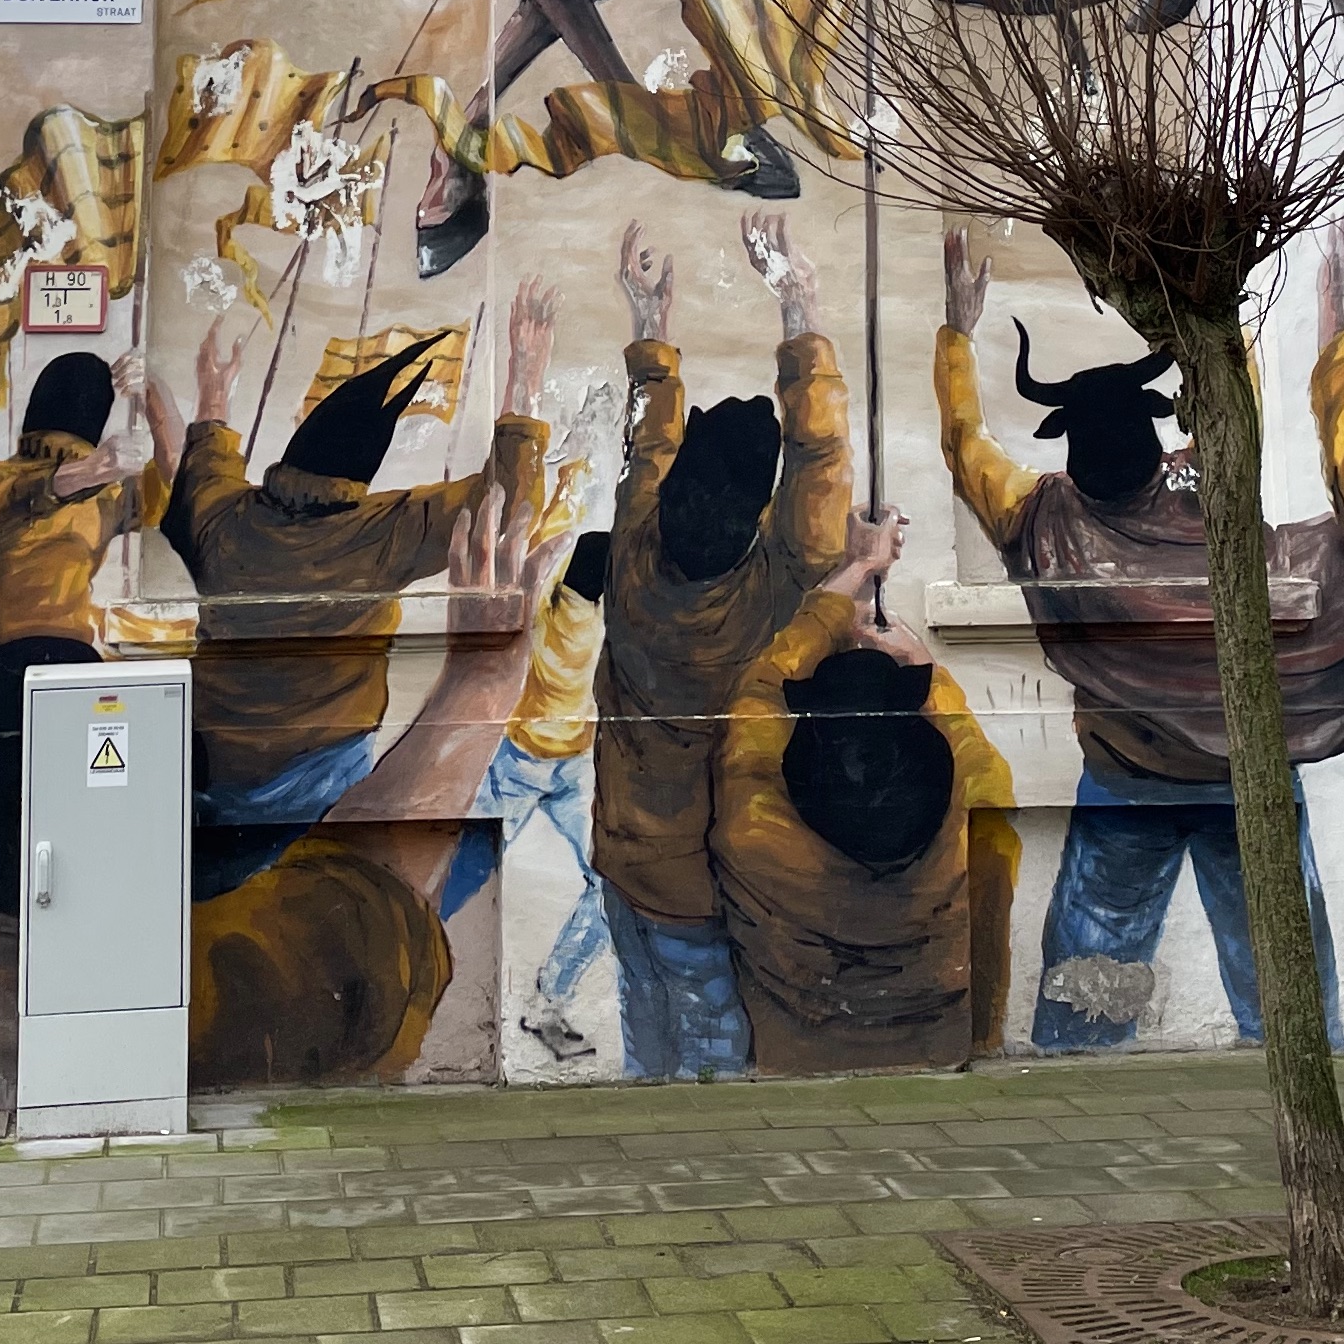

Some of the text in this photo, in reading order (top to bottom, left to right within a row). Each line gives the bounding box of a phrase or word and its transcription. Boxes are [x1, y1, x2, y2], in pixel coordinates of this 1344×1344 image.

[96, 7, 137, 17] STRAAT
[45, 271, 87, 286] H 90
